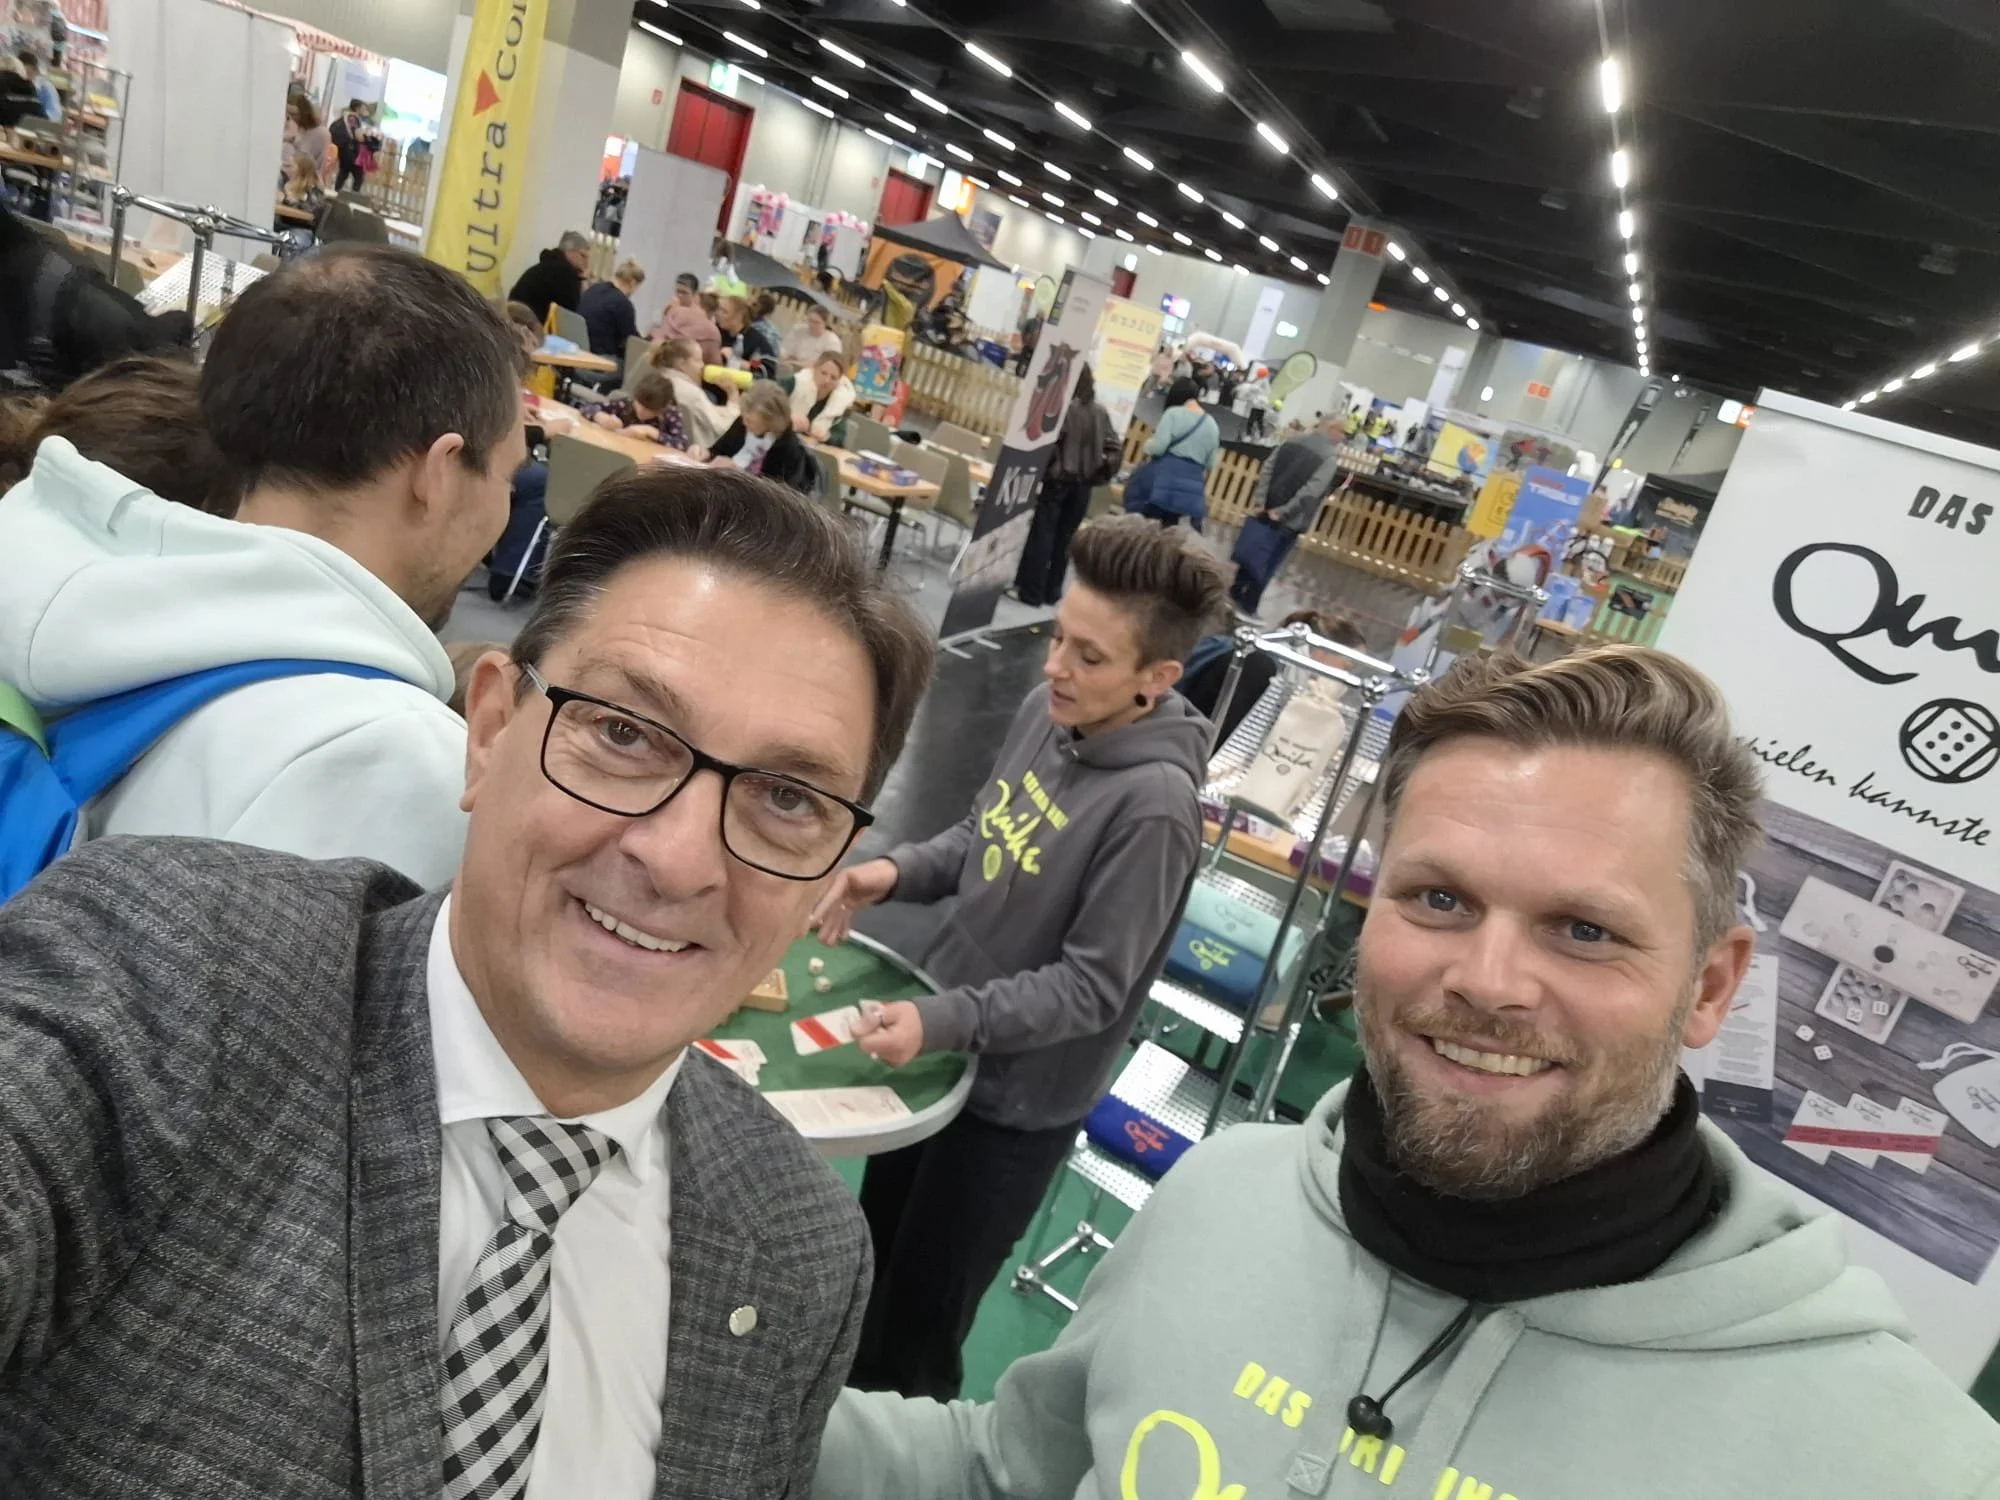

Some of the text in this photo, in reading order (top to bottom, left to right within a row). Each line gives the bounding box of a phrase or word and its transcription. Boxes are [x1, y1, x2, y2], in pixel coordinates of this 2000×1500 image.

[1907, 485, 1994, 535] DAS
[1848, 771, 1992, 847] kannste
[1233, 1361, 1313, 1429] DAS
